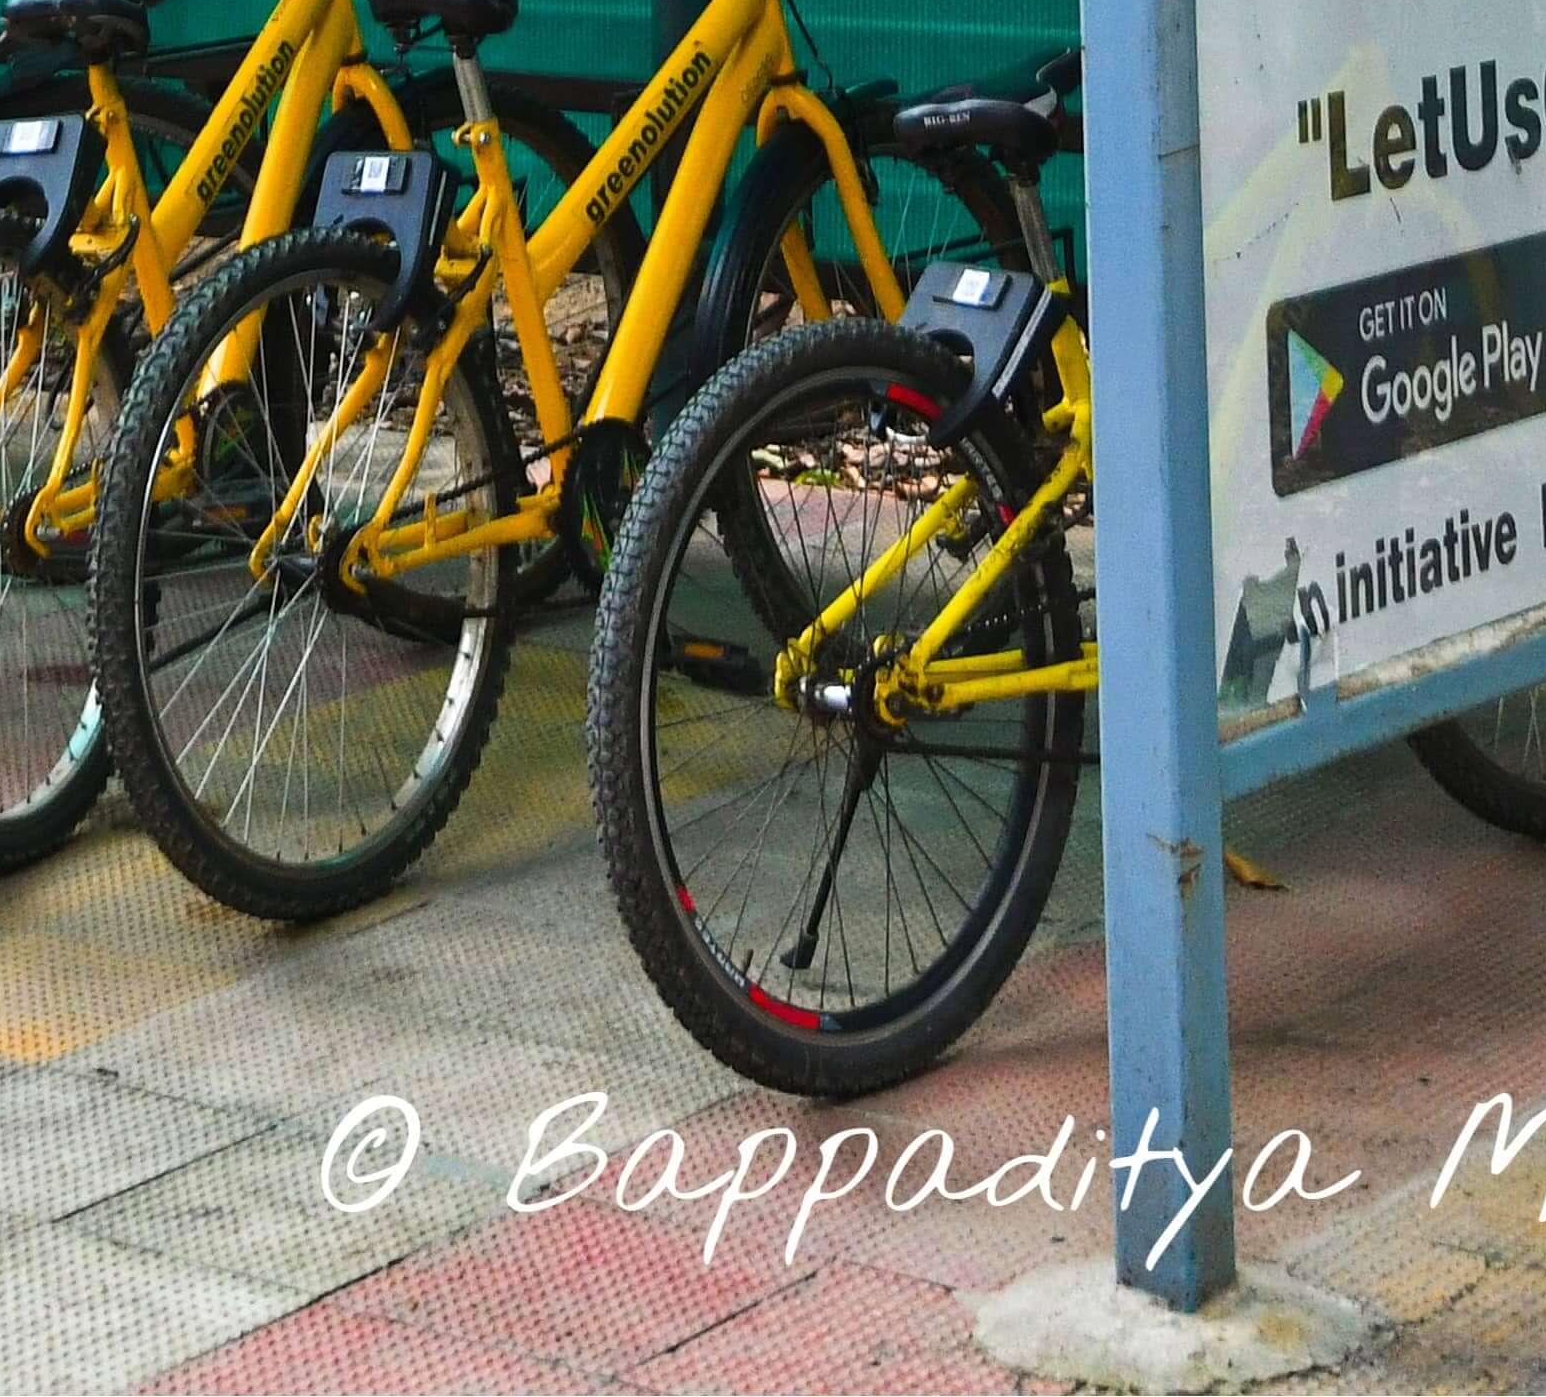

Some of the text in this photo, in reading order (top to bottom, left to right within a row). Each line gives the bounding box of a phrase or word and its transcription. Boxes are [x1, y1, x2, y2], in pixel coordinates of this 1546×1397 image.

[194, 38, 297, 202] greenolution
[583, 41, 714, 225] greenolution
[1359, 287, 1447, 341] GET IT ON
[1362, 320, 1543, 424] Google Play
[1335, 508, 1518, 624] initiative
